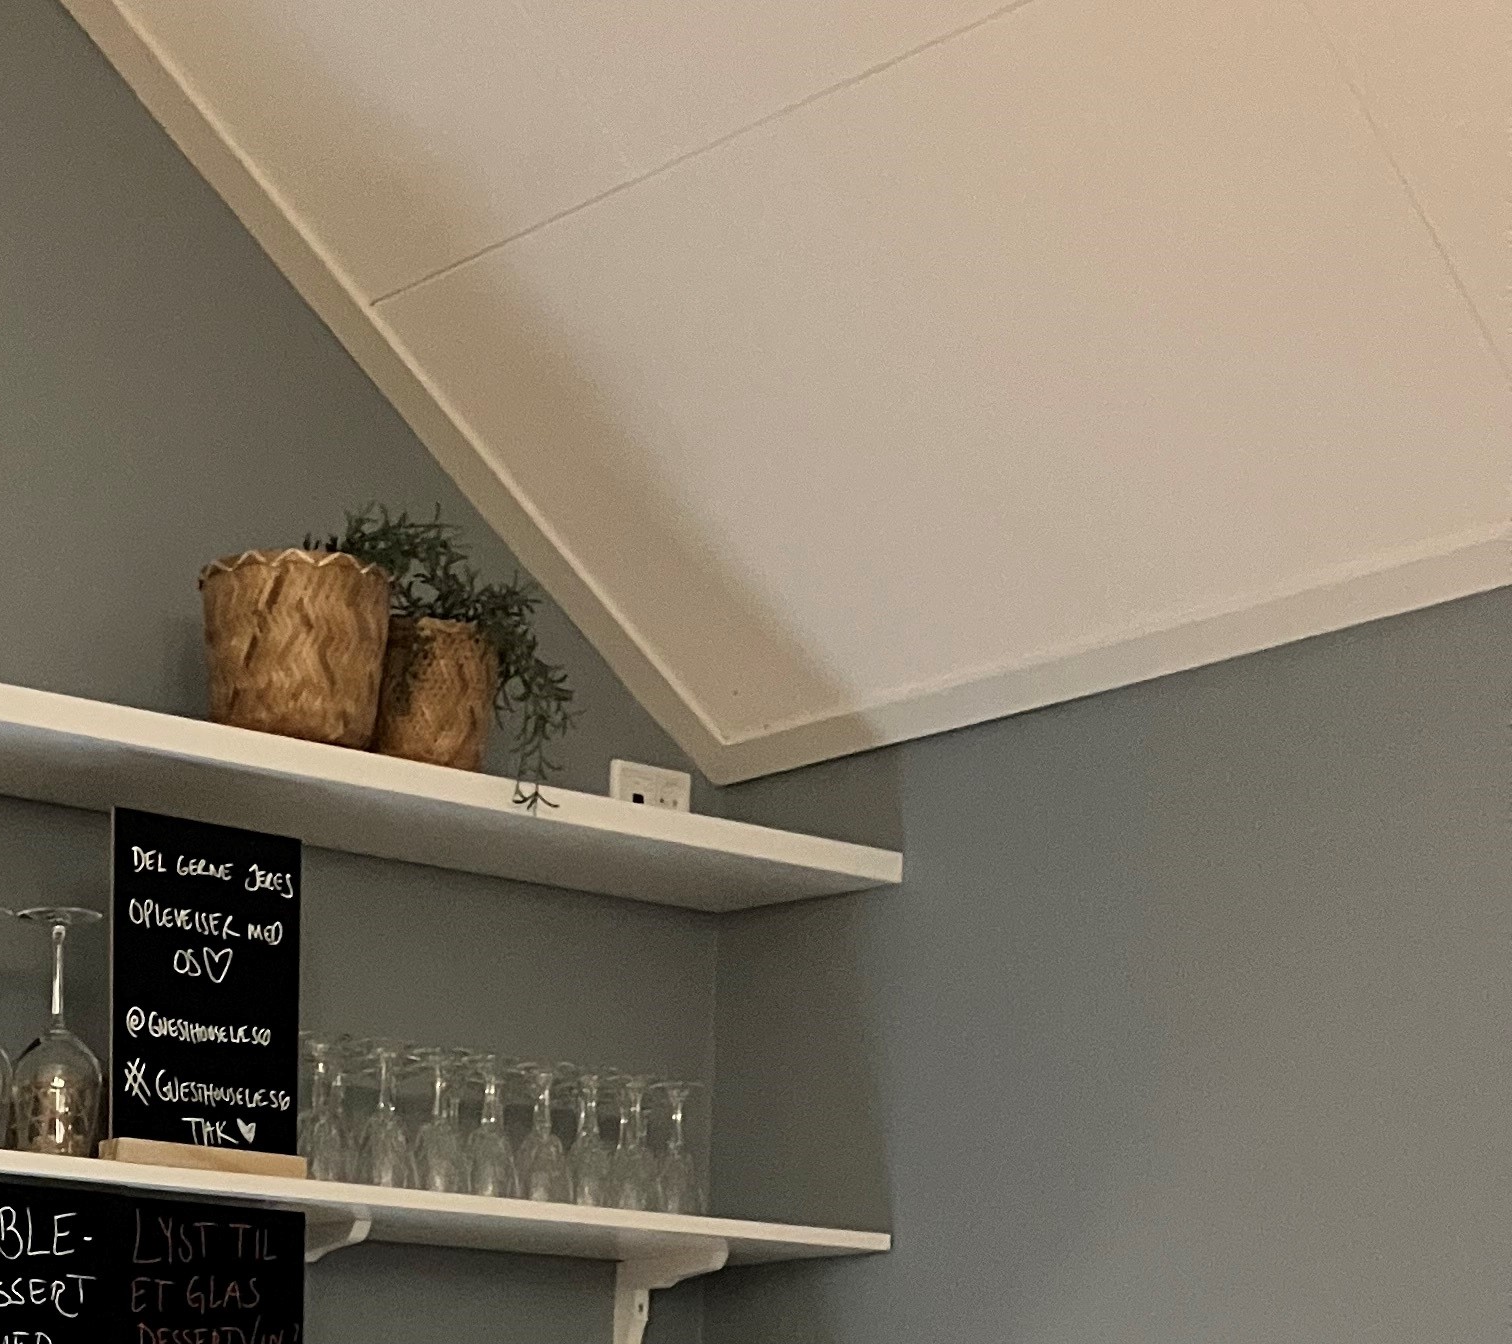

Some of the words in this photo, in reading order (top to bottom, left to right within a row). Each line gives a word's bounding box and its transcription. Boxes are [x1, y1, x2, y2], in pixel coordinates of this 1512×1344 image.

[131, 846, 168, 873] DEL
[176, 855, 234, 881] GERNE
[244, 863, 294, 899] JERES
[247, 921, 284, 946] MED
[173, 949, 202, 977] OS
[181, 1117, 239, 1147] TAK
[131, 1208, 218, 1264] LYST
[228, 1222, 278, 1262] TIL
[131, 1276, 175, 1313] ET
[186, 1275, 261, 1315] GLAS
